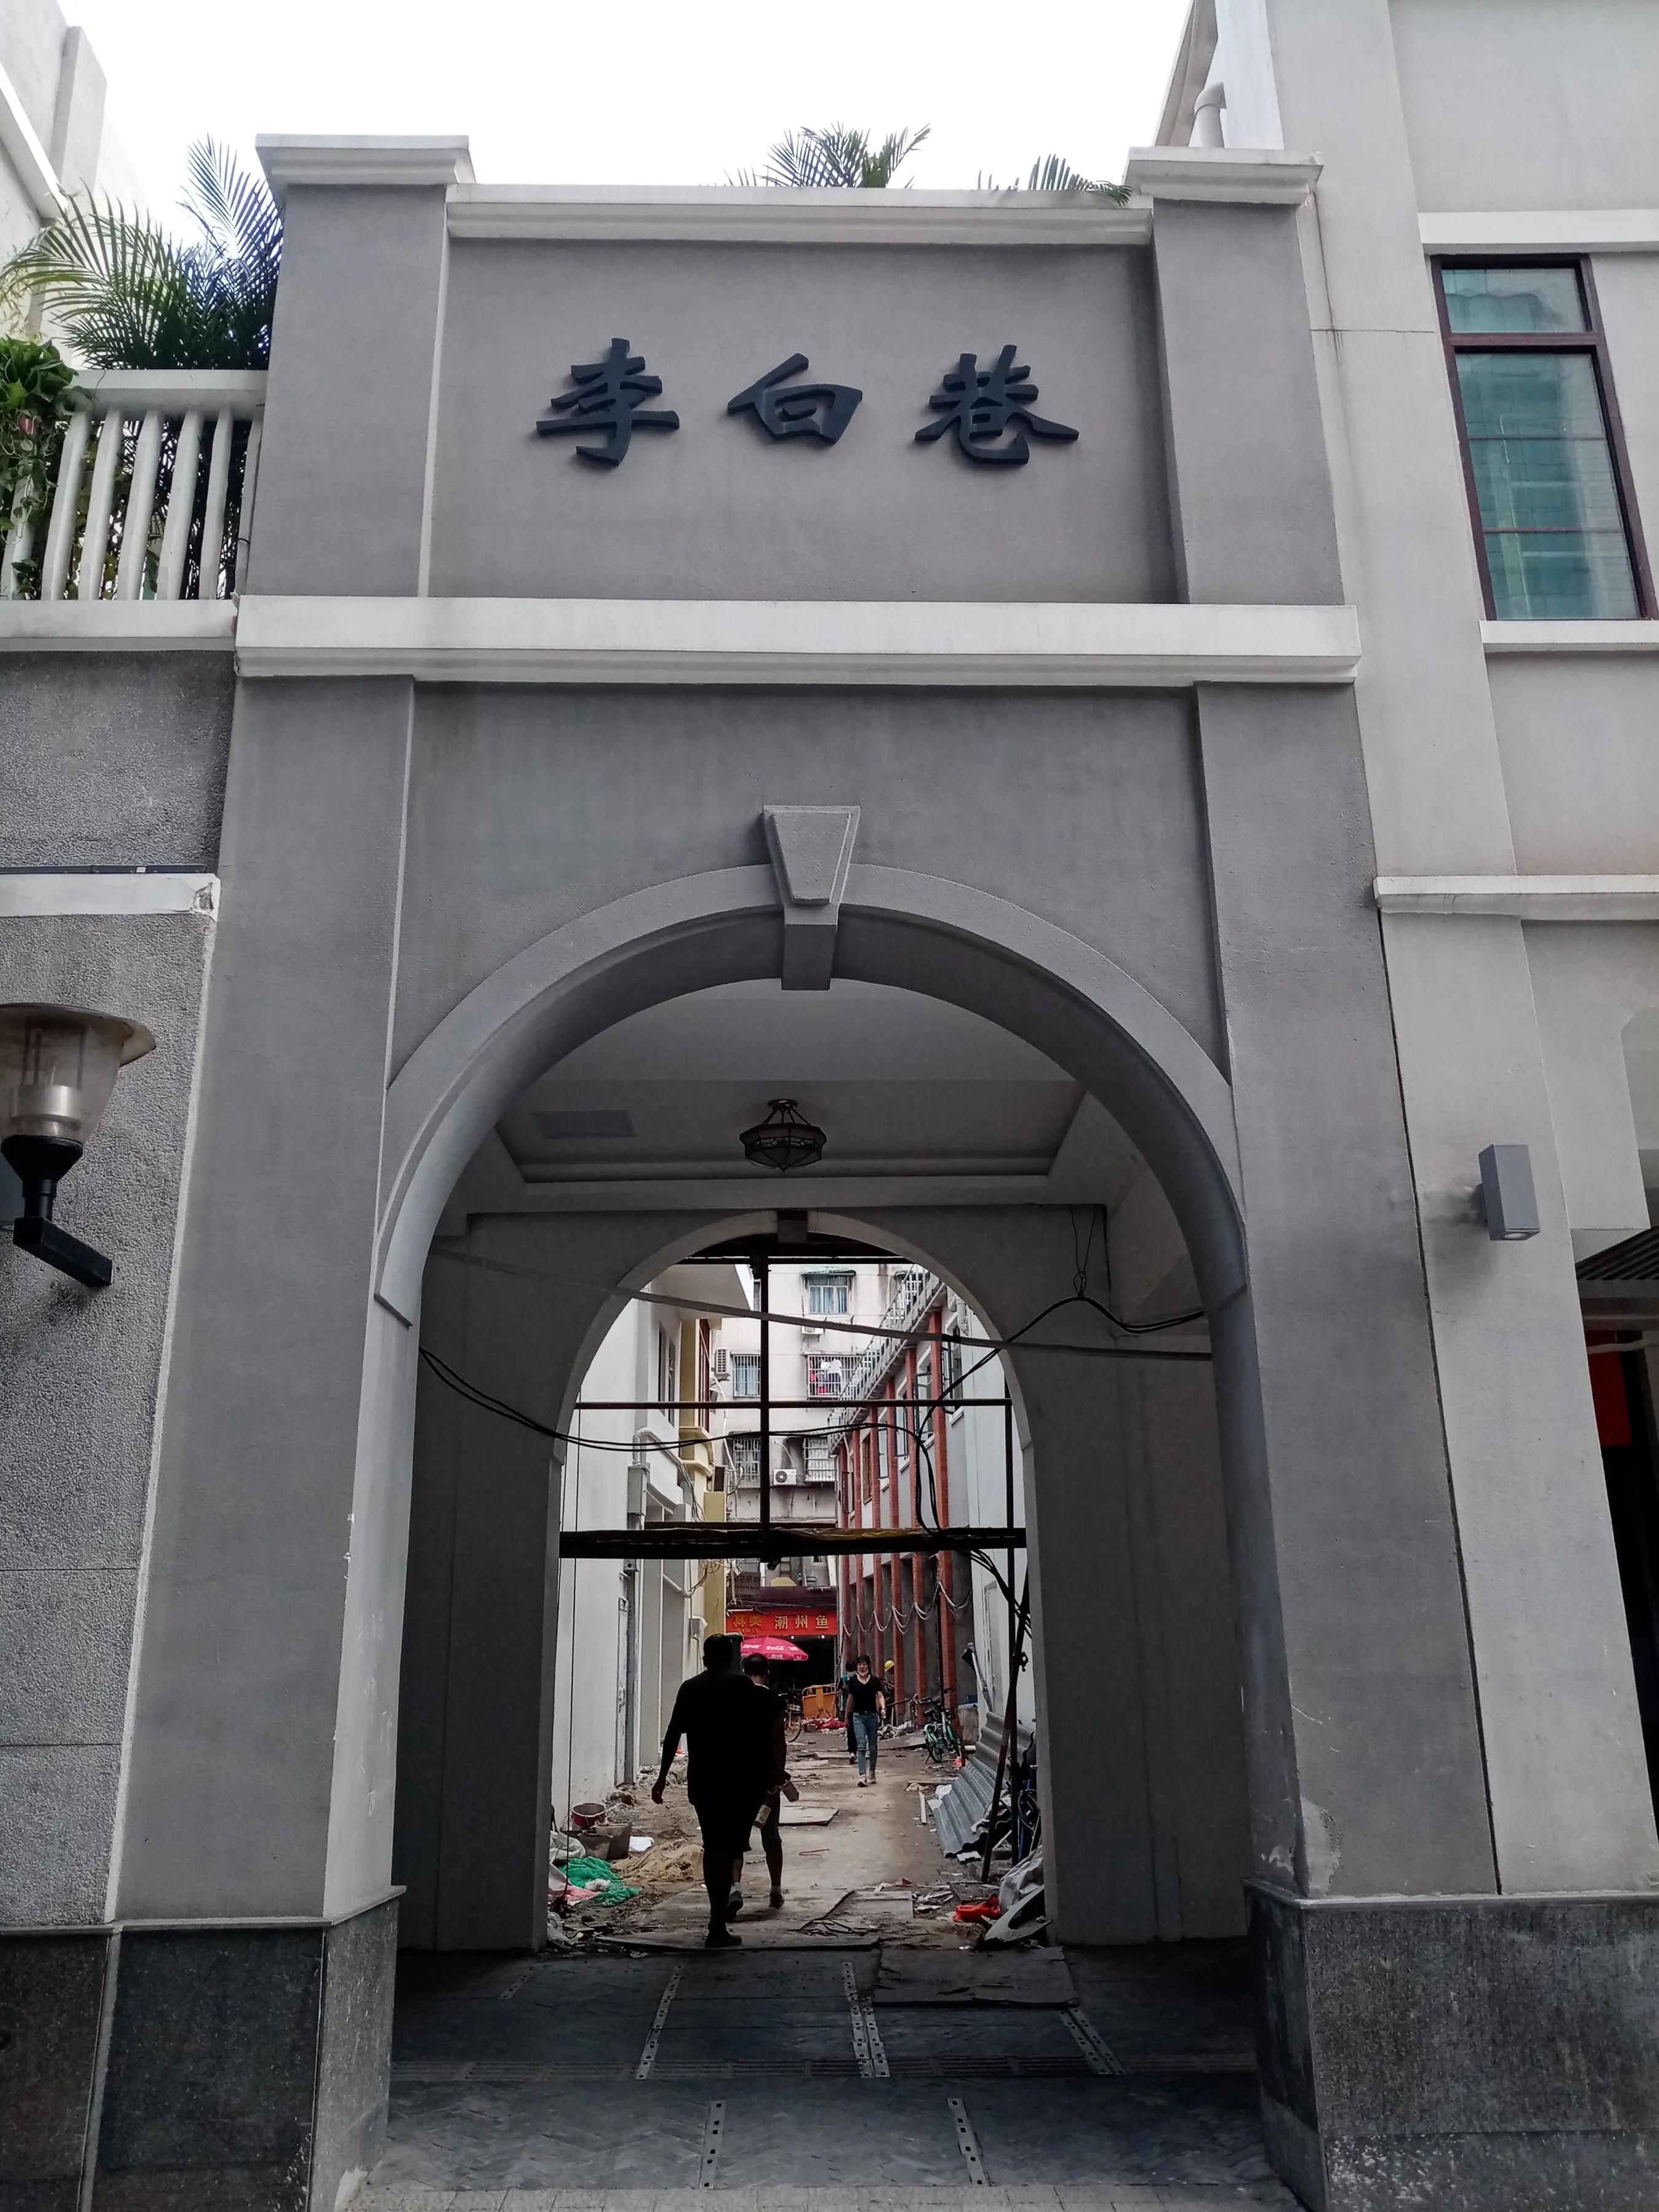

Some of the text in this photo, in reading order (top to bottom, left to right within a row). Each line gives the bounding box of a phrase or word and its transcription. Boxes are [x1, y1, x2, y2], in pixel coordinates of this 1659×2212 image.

[536, 338, 1079, 466] 李白巷
[774, 1615, 829, 1629] 潮州鱼
